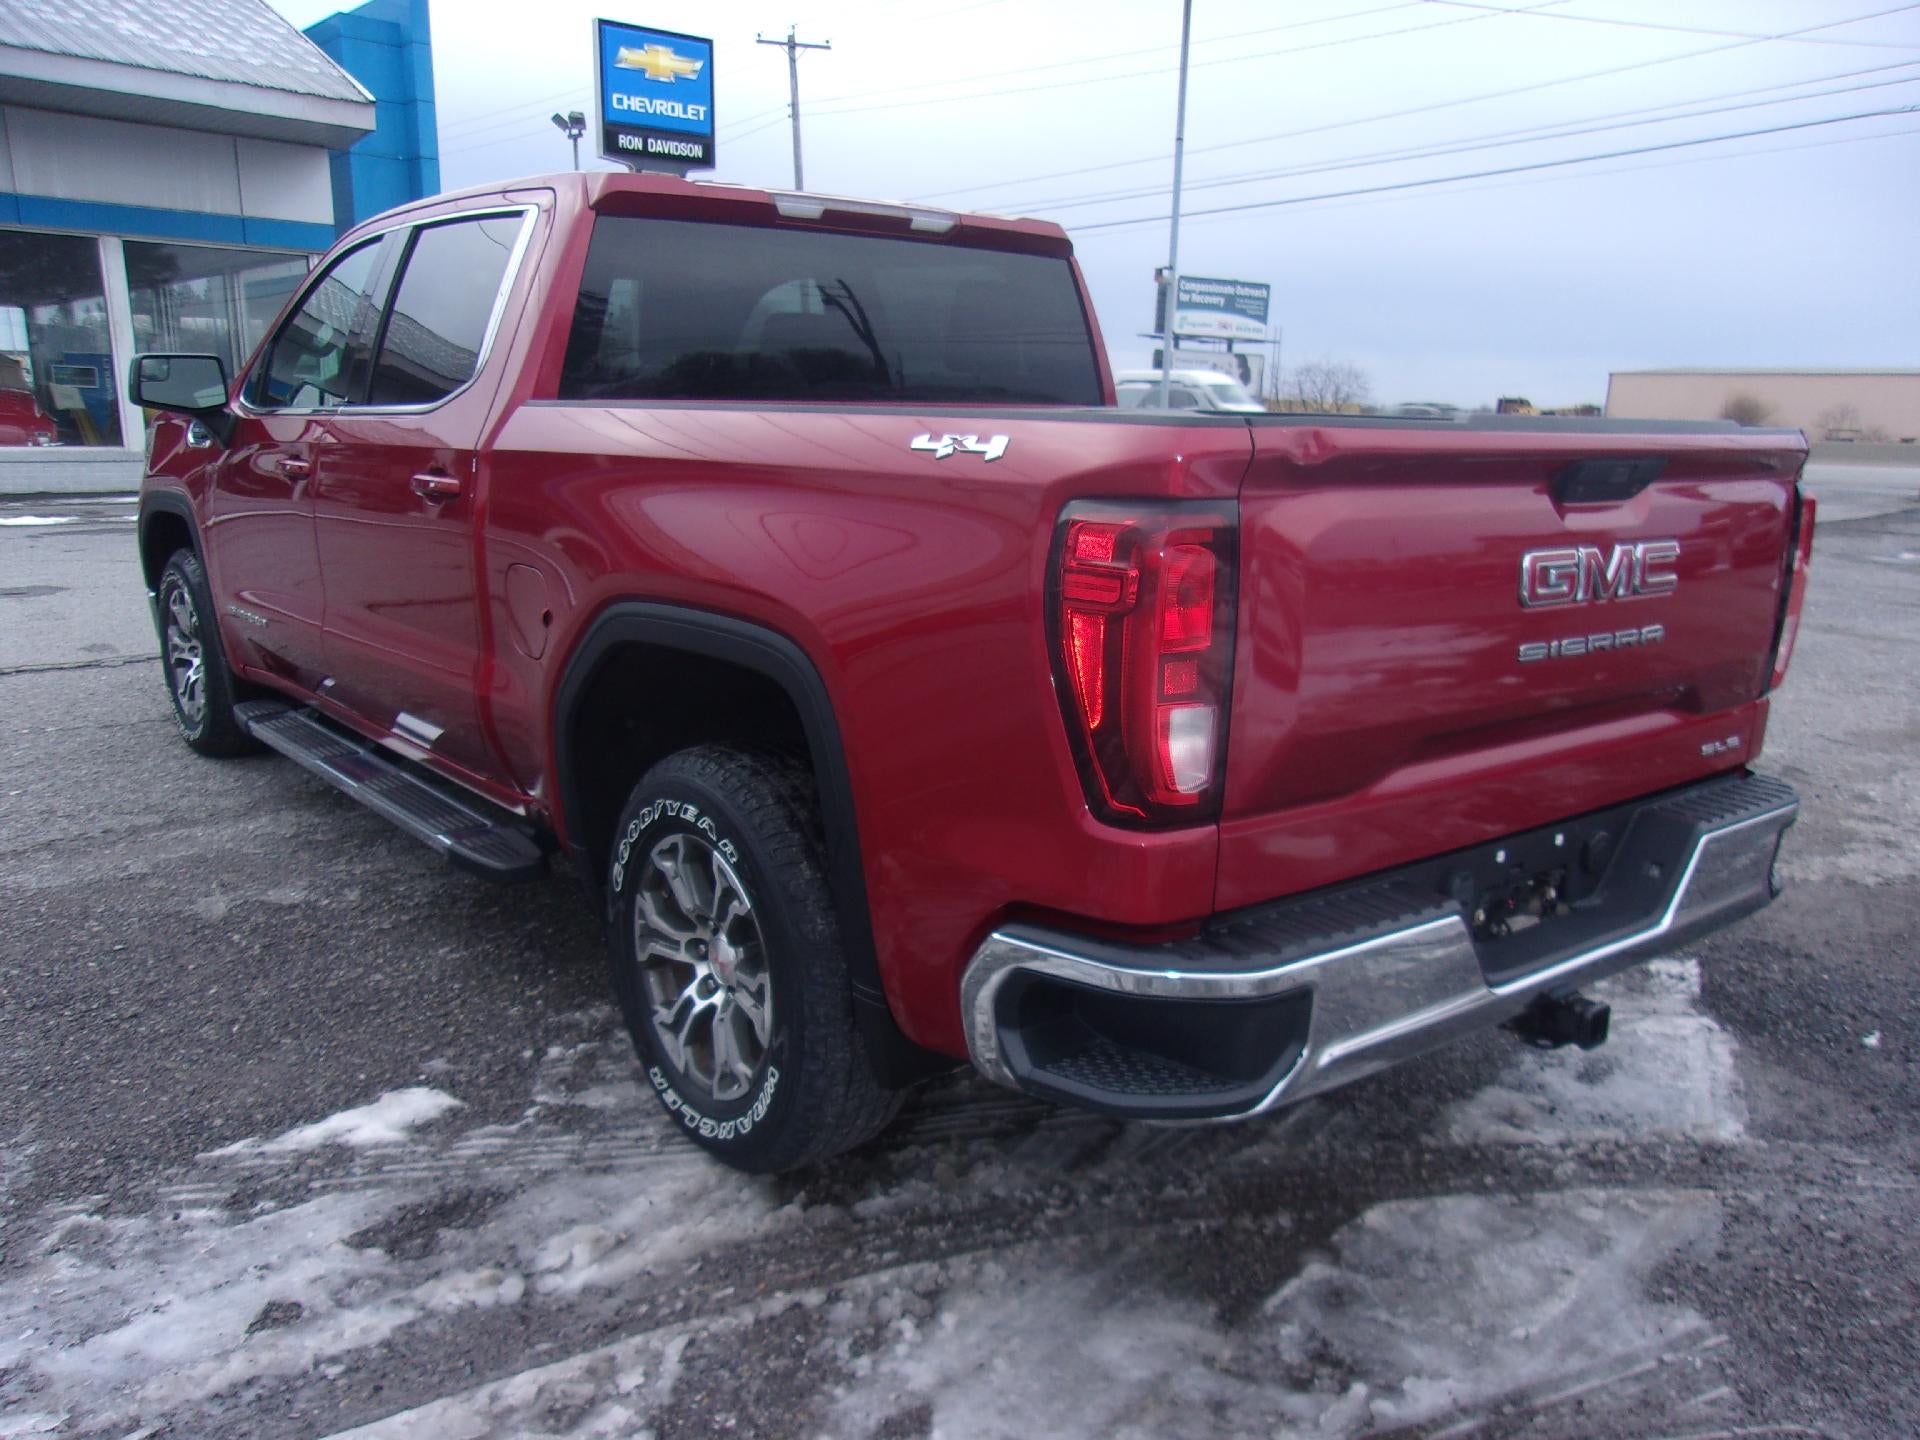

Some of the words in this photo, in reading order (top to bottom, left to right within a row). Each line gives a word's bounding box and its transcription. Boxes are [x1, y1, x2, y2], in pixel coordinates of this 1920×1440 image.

[612, 93, 707, 121] CHEVROLET
[618, 134, 643, 151] RON
[648, 138, 703, 158] DAVIDSON
[1518, 539, 1681, 611] GMC
[1518, 624, 1665, 663] SIERRA
[612, 798, 740, 892] GOODYEAR
[649, 1065, 780, 1140] WRANGLER
